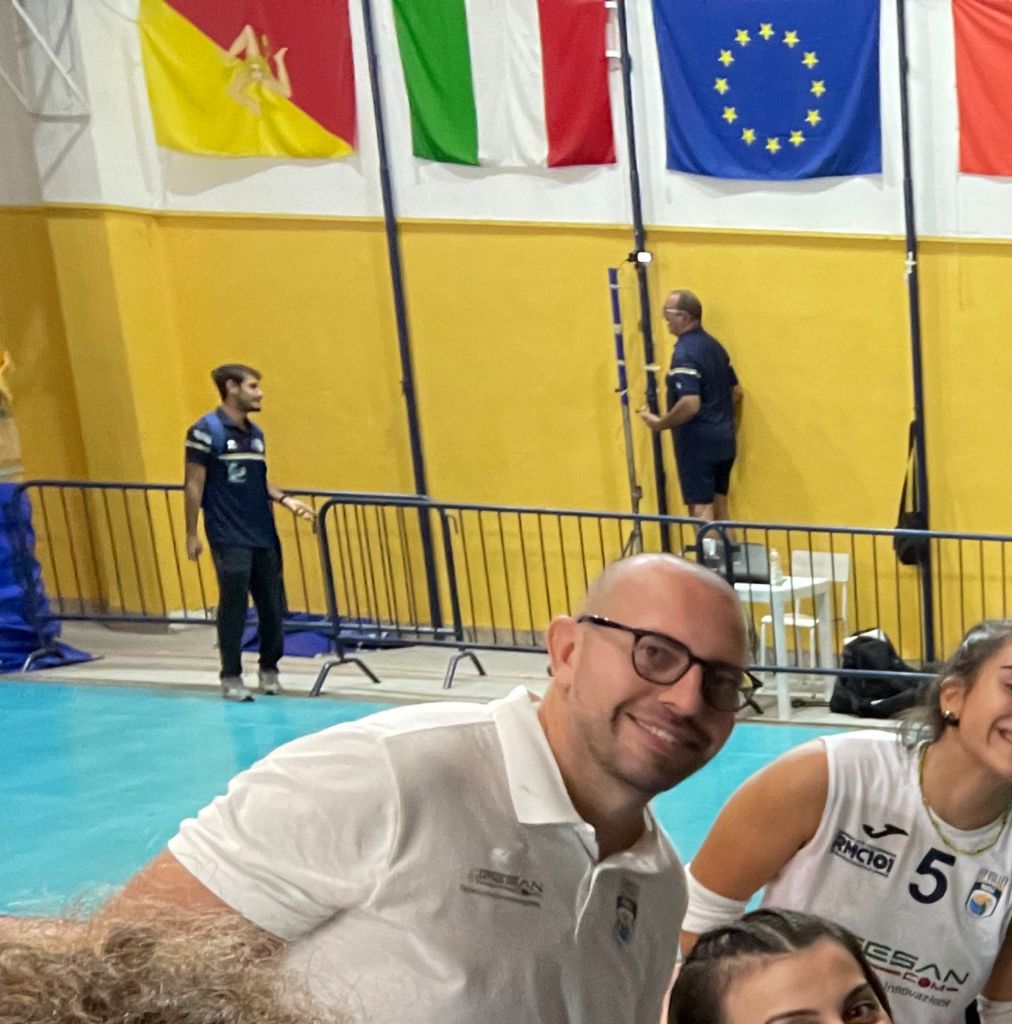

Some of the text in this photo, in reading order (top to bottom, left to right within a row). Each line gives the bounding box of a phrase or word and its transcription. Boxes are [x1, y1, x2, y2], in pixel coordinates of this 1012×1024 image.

[831, 834, 895, 873] RMC101
[908, 847, 956, 905] 5
[857, 936, 969, 985] ESAN
